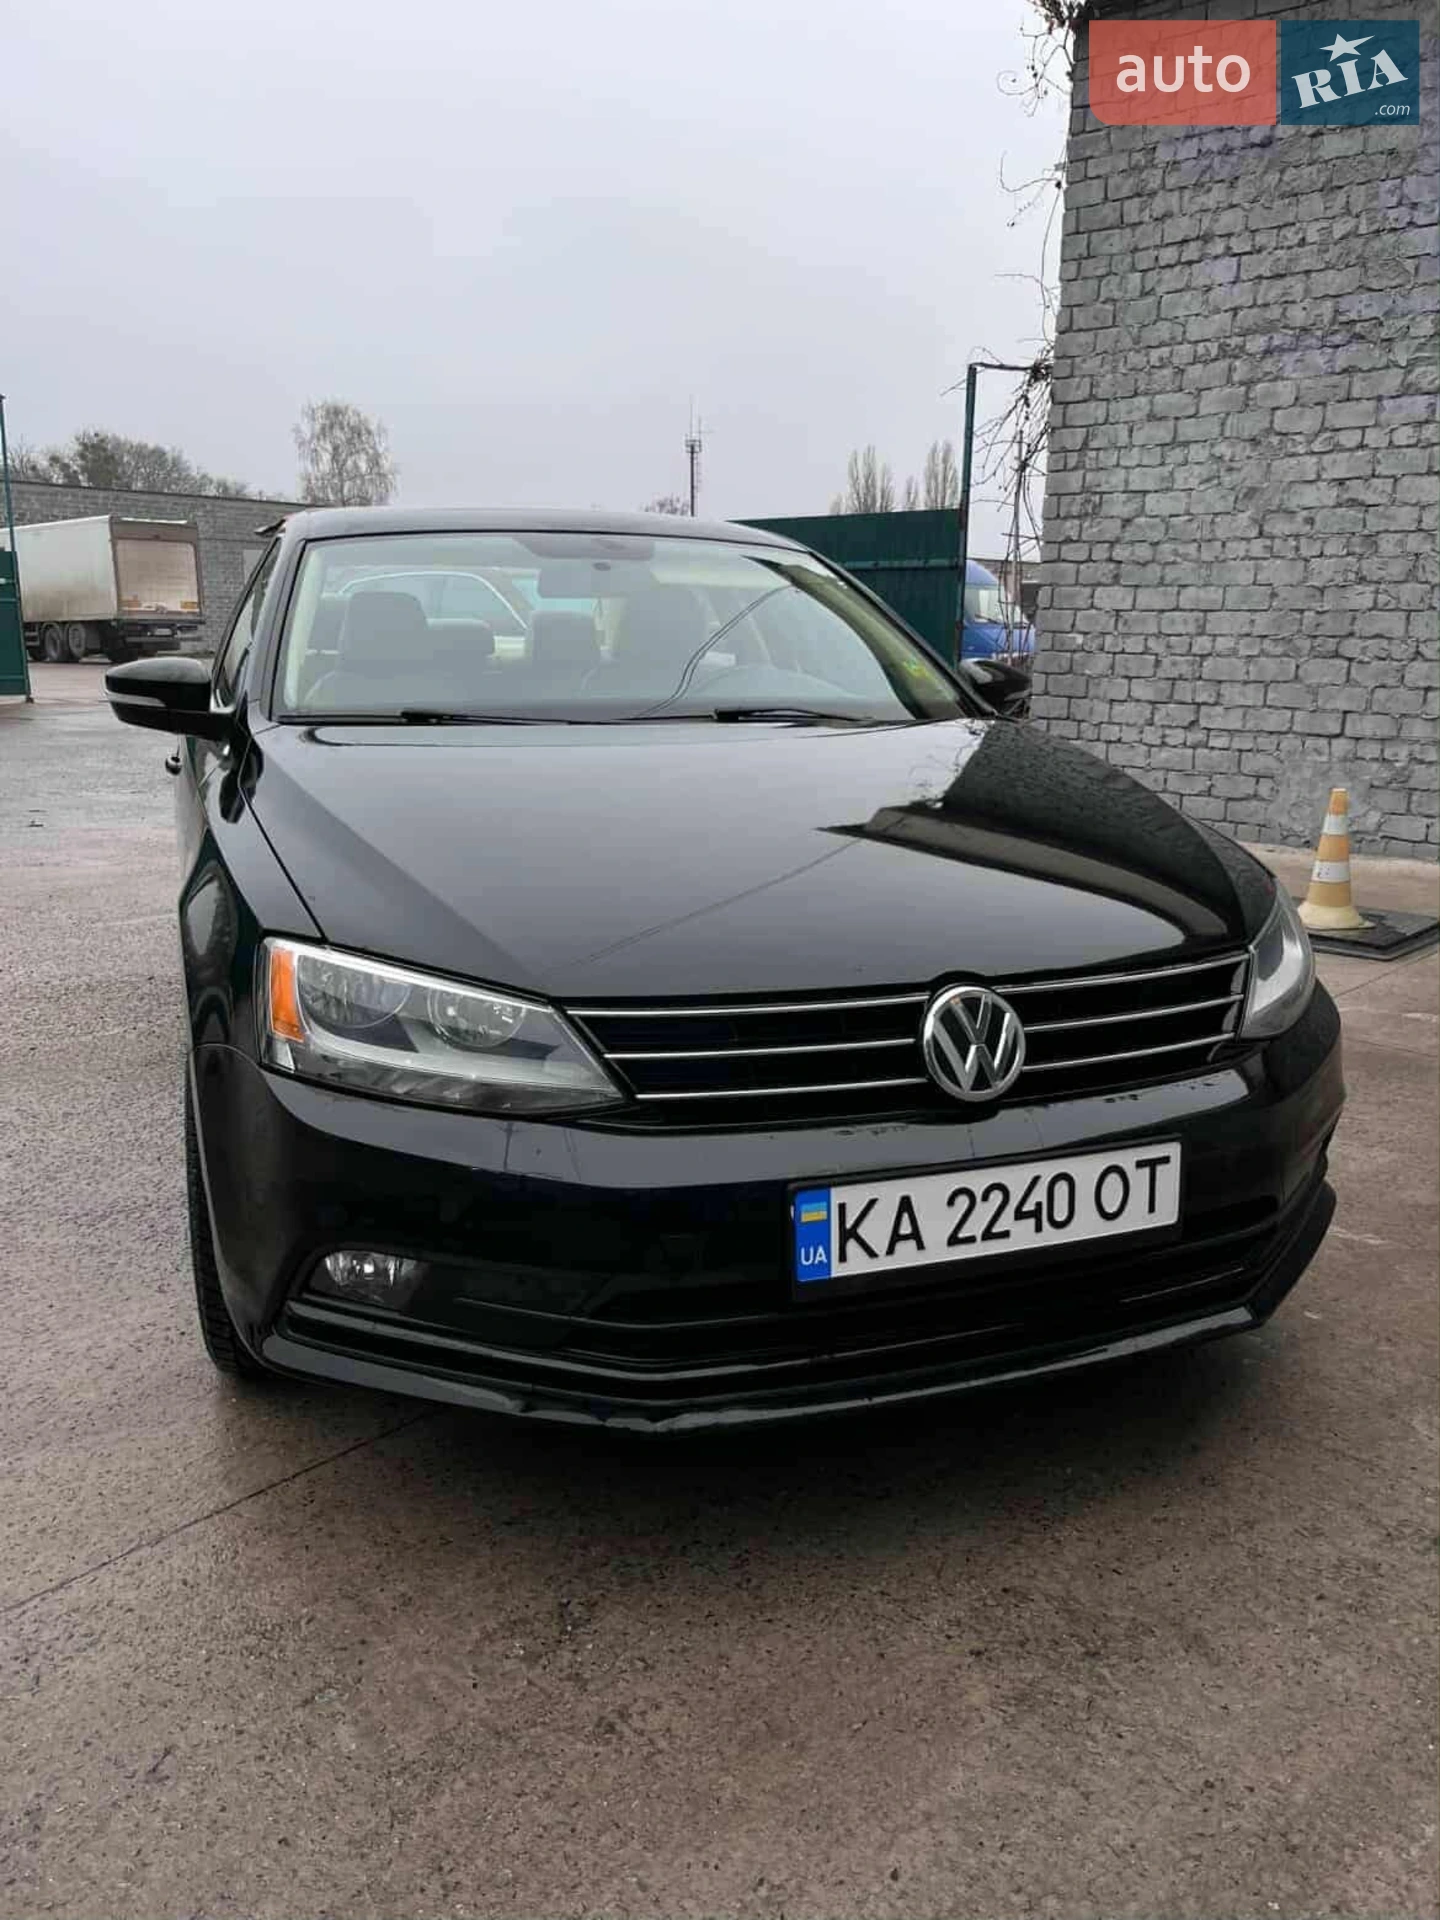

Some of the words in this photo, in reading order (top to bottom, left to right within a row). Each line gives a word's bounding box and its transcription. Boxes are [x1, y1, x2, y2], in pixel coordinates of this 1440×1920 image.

[838, 1195, 926, 1263] KA
[946, 1172, 1076, 1247] 2240
[1094, 1155, 1171, 1222] OT
[800, 1247, 828, 1266] UA
